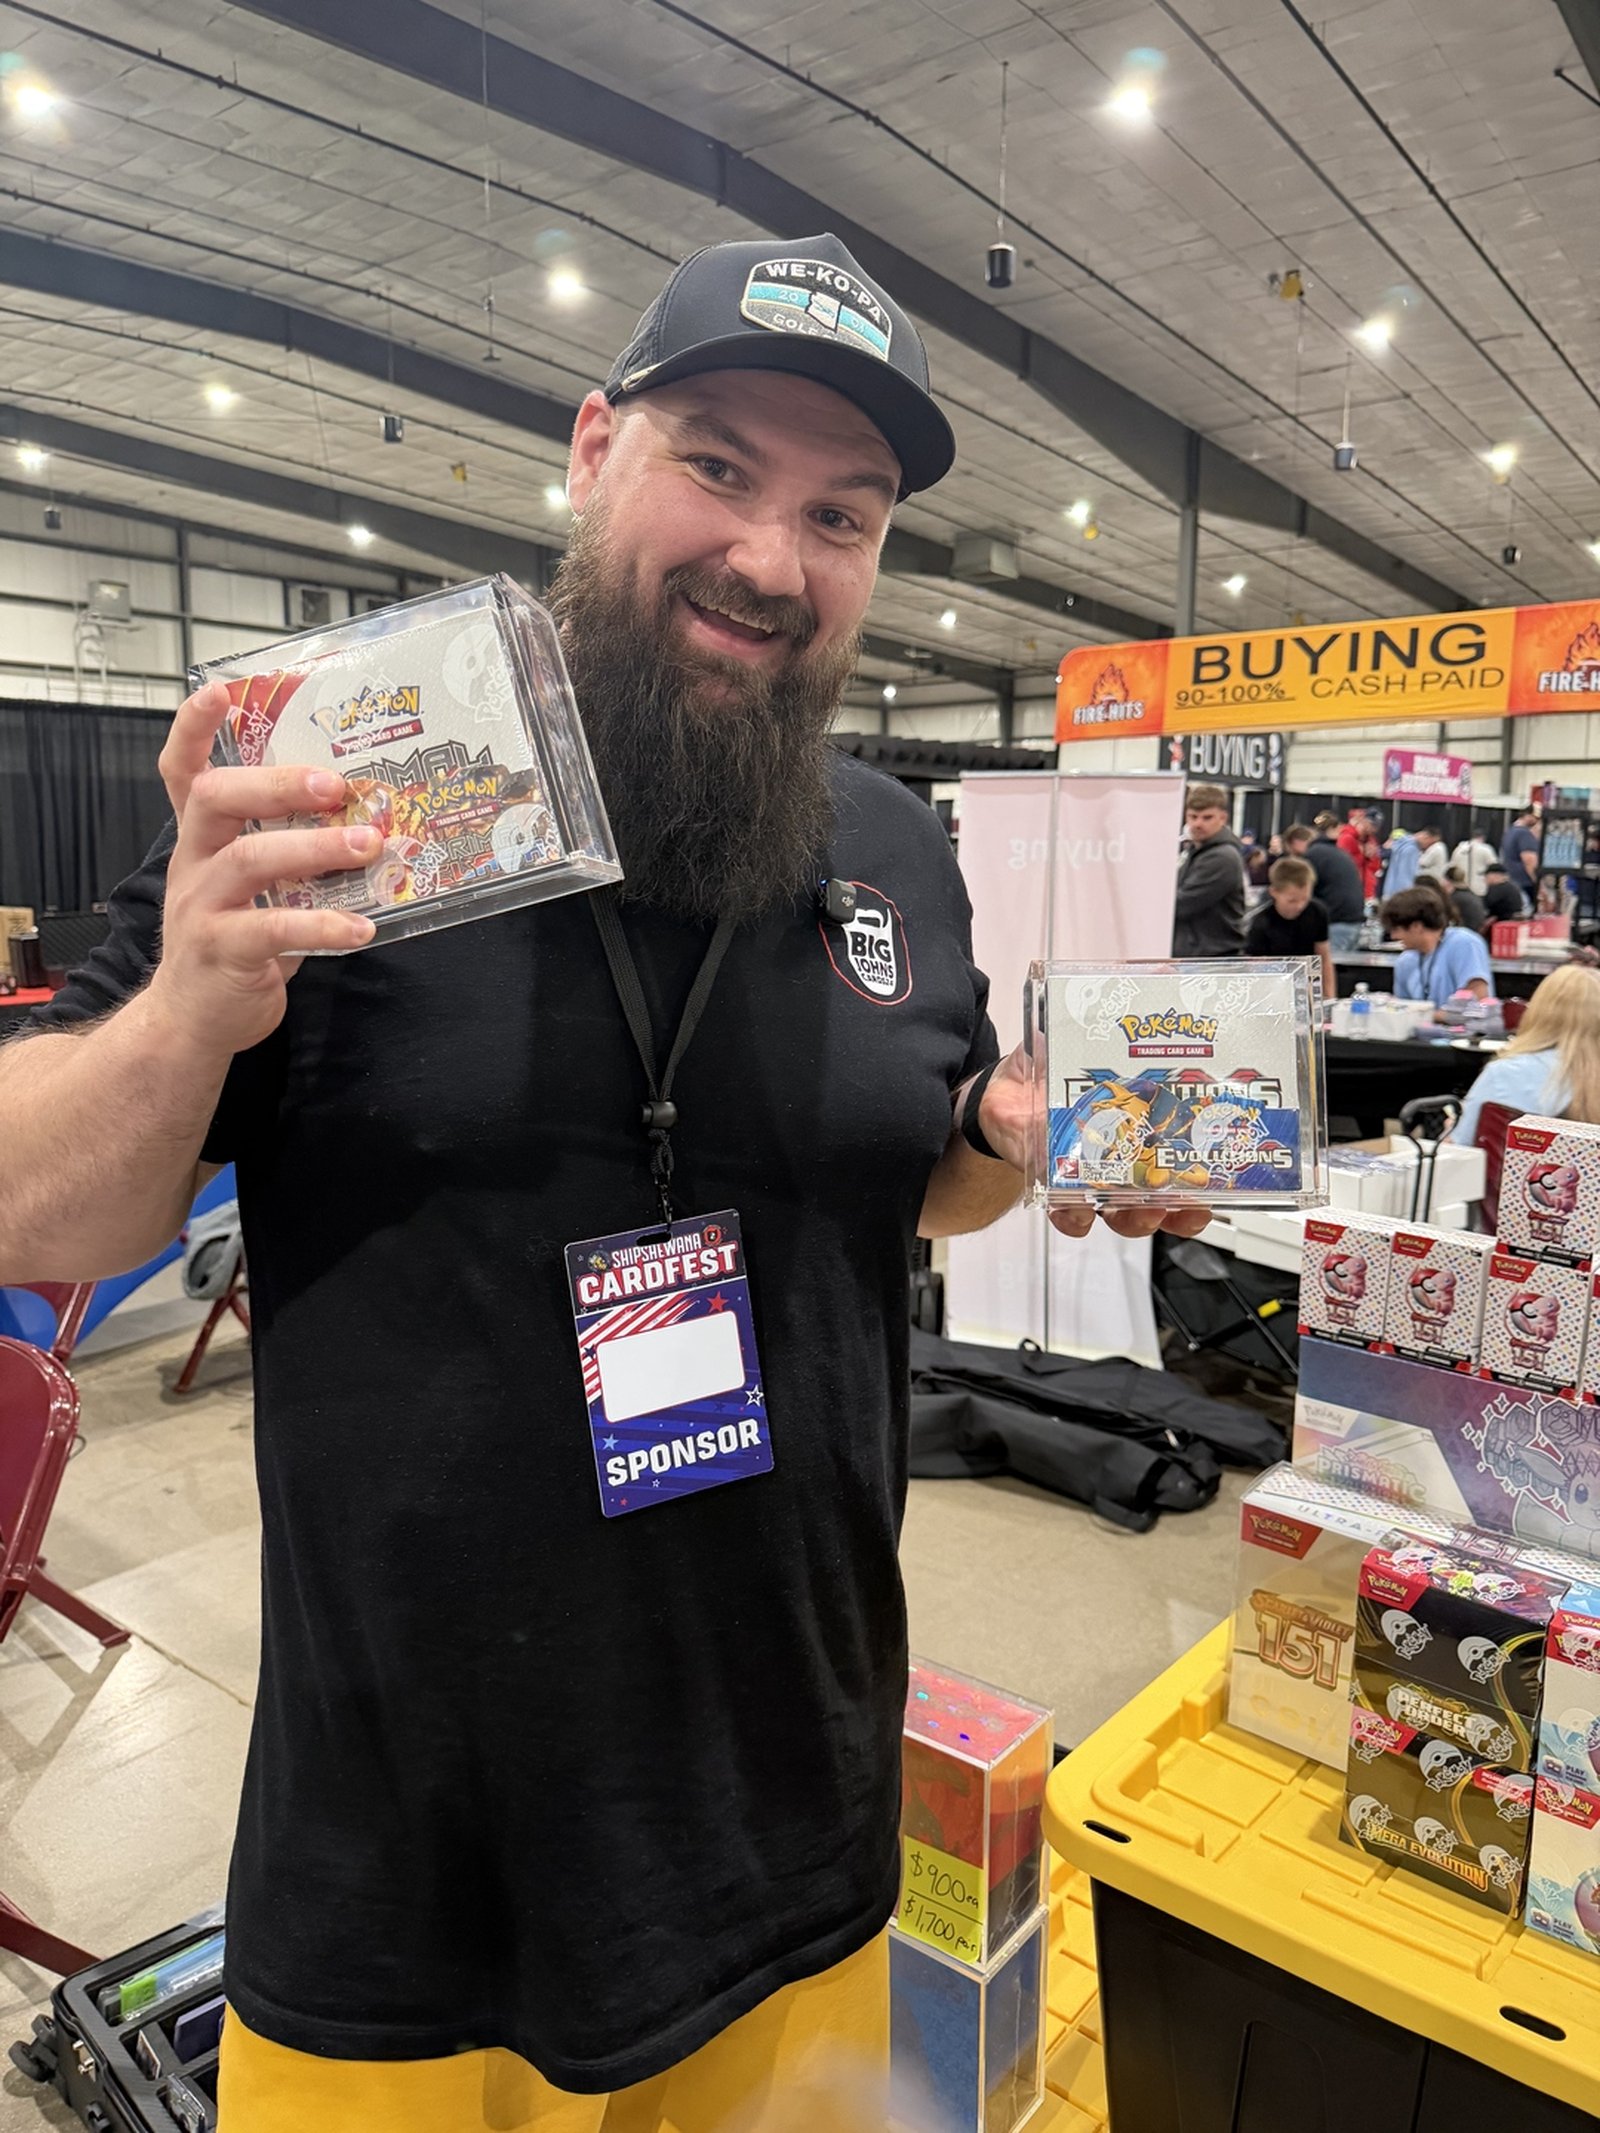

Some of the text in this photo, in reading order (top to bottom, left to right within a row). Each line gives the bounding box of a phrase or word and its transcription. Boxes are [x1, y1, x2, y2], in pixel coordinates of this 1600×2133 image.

[766, 263, 881, 324] WE-KO-PA
[1192, 622, 1486, 685] BUYING
[1176, 666, 1505, 708] 90-100% CASH PAID
[850, 931, 892, 963] BIG
[577, 1242, 737, 1305] CARDFEST
[611, 1232, 702, 1269] SHIPSHEWANA
[605, 1418, 762, 1487] SPONSOR
[1256, 1608, 1342, 1692] 151
[1397, 1689, 1478, 1728] PERFECT
[1404, 1706, 1471, 1739] ORDER
[909, 1850, 966, 1904] $900
[902, 1896, 956, 1941] $1,700
